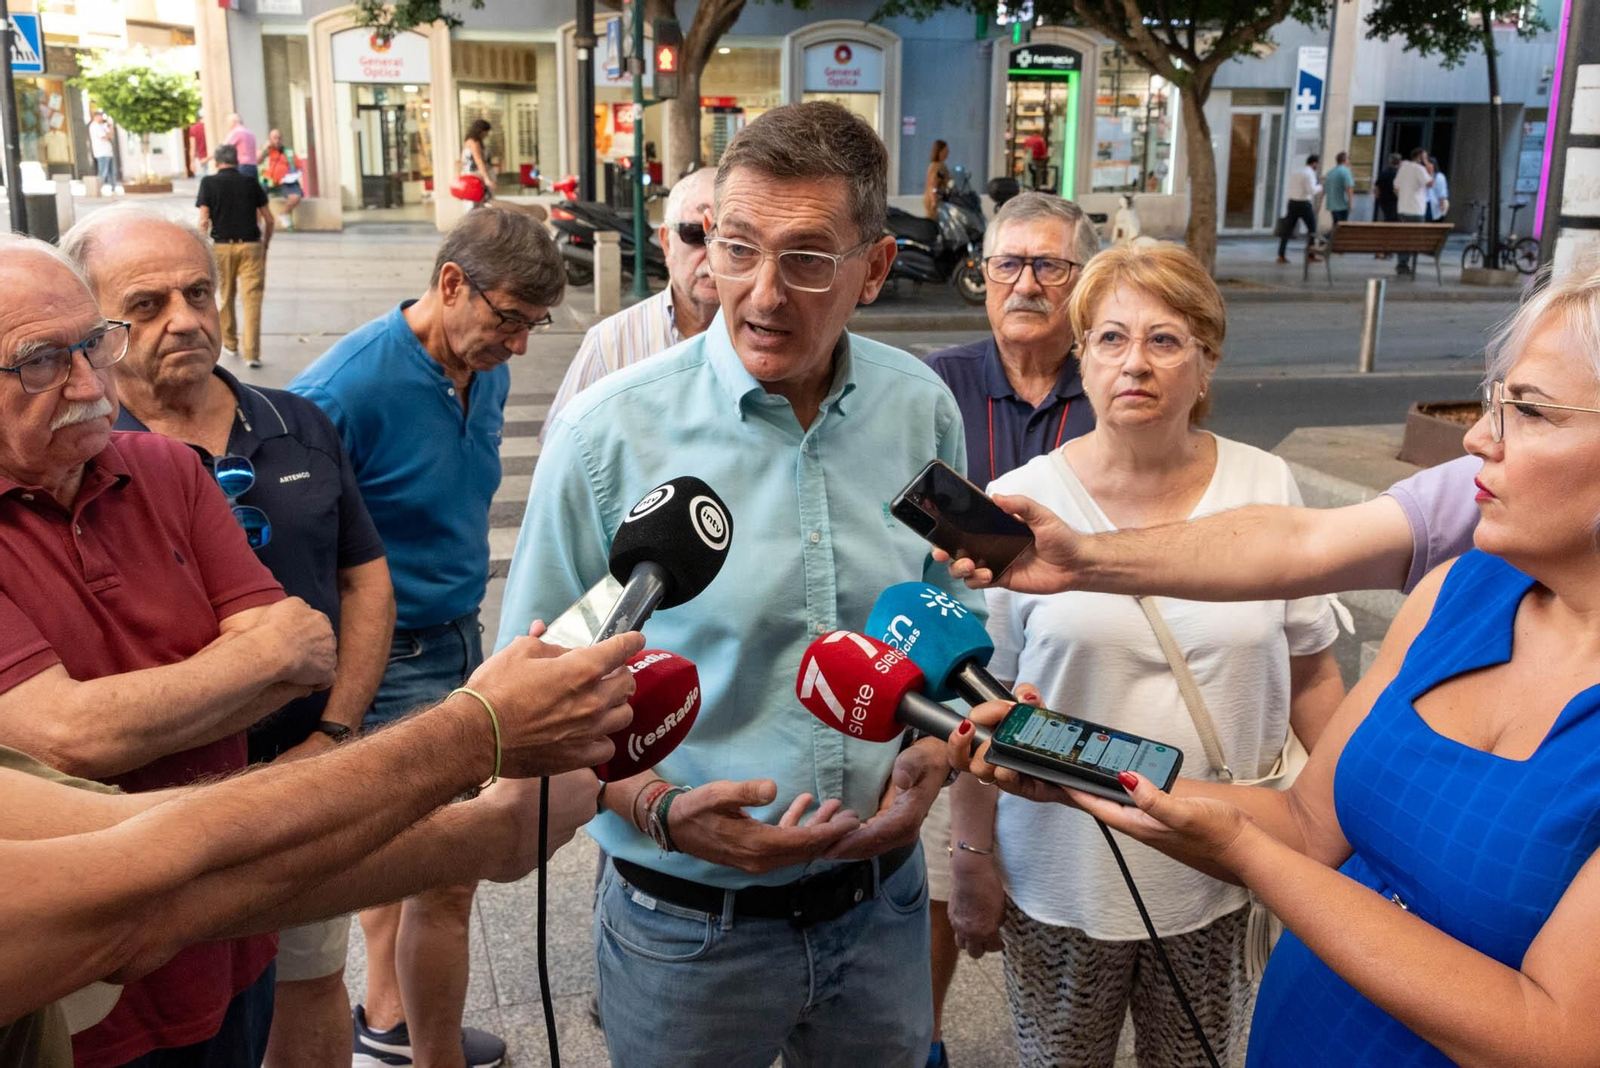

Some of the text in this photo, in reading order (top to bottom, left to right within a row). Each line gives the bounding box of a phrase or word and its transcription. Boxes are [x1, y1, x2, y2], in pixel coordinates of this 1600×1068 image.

[359, 57, 403, 66] General
[824, 67, 862, 77] General
[280, 471, 310, 483] ARTENGO
[702, 509, 721, 533] intv
[643, 686, 699, 747] esRadio
